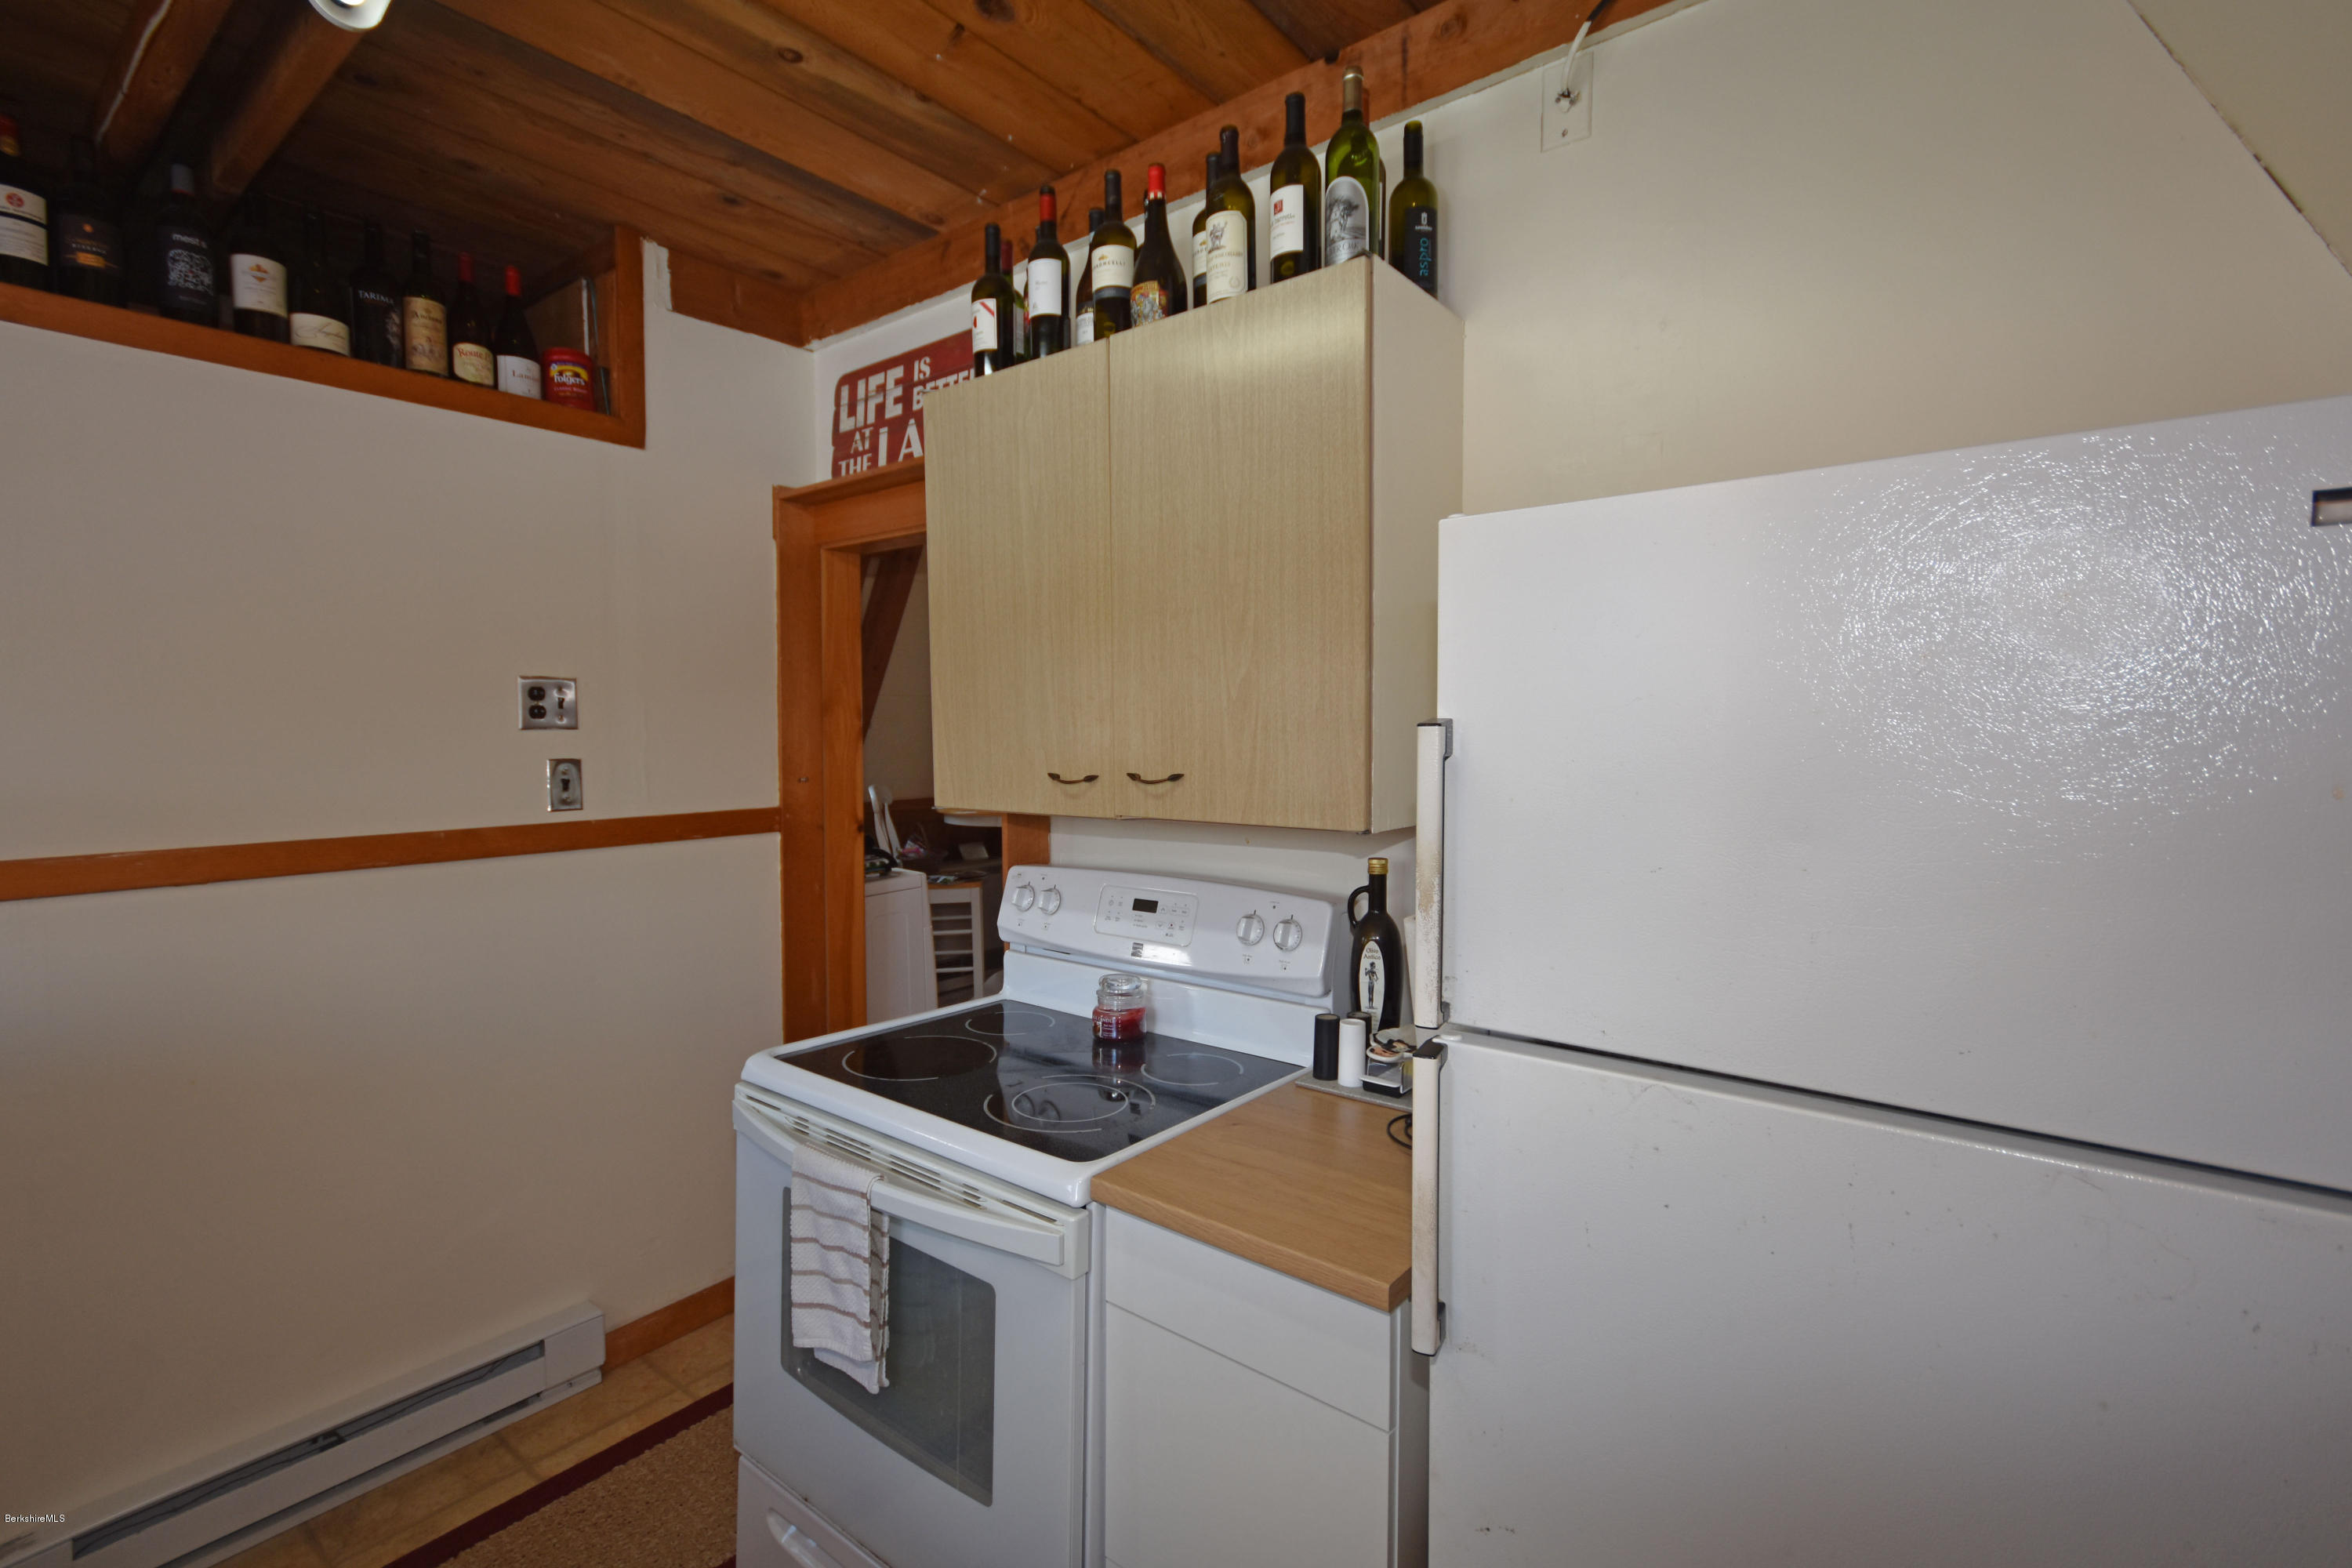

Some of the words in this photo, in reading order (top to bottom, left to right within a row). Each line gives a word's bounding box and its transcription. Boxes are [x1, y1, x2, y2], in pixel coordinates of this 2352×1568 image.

[1419, 238, 1432, 276] aspro
[358, 289, 395, 307] TARIMA
[839, 365, 904, 433] LIFE
[913, 357, 931, 383] IS
[851, 426, 873, 454] AT
[839, 453, 872, 477] THE
[1098, 1015, 1116, 1024] CANDL
